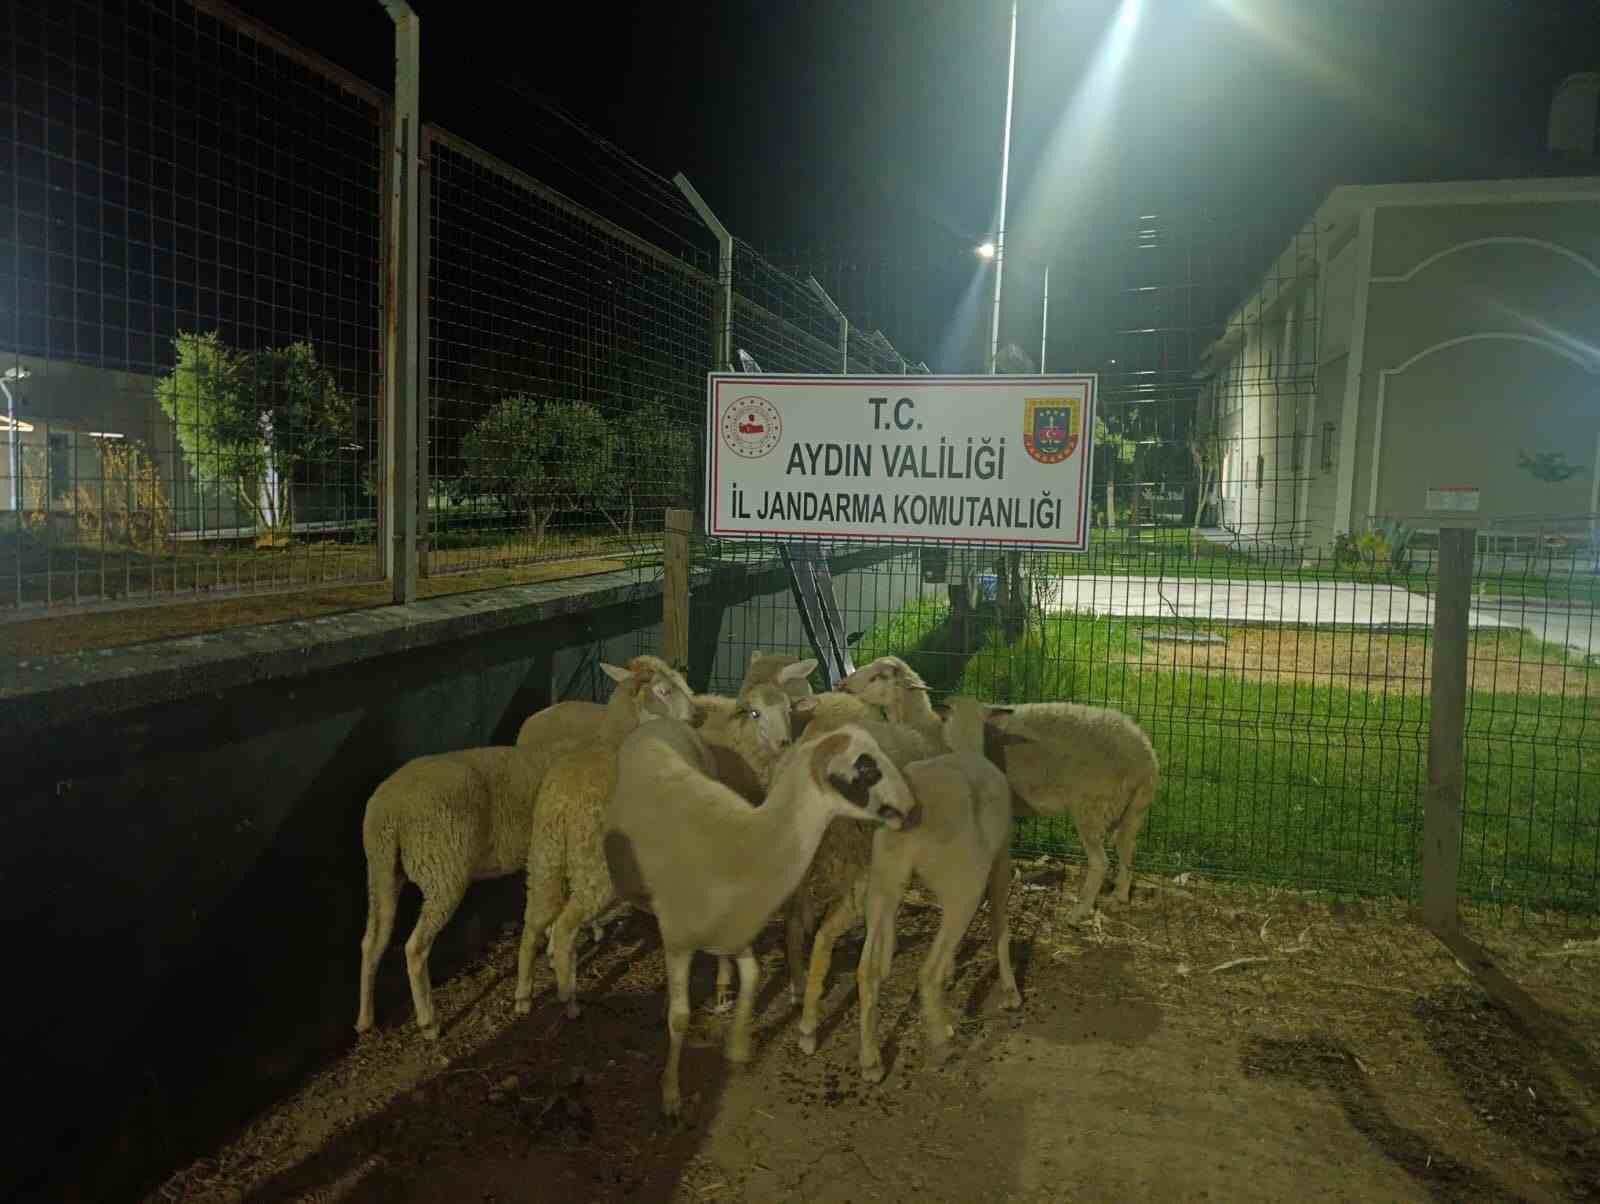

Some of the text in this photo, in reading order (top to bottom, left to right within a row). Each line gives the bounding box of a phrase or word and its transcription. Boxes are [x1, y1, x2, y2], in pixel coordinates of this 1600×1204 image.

[868, 397, 923, 430] T.C.
[786, 442, 872, 476] AYDIN
[881, 436, 1005, 479] VALİLİĞİ
[731, 482, 1062, 529] İL JANDARMA KOMUTANLIĞI
